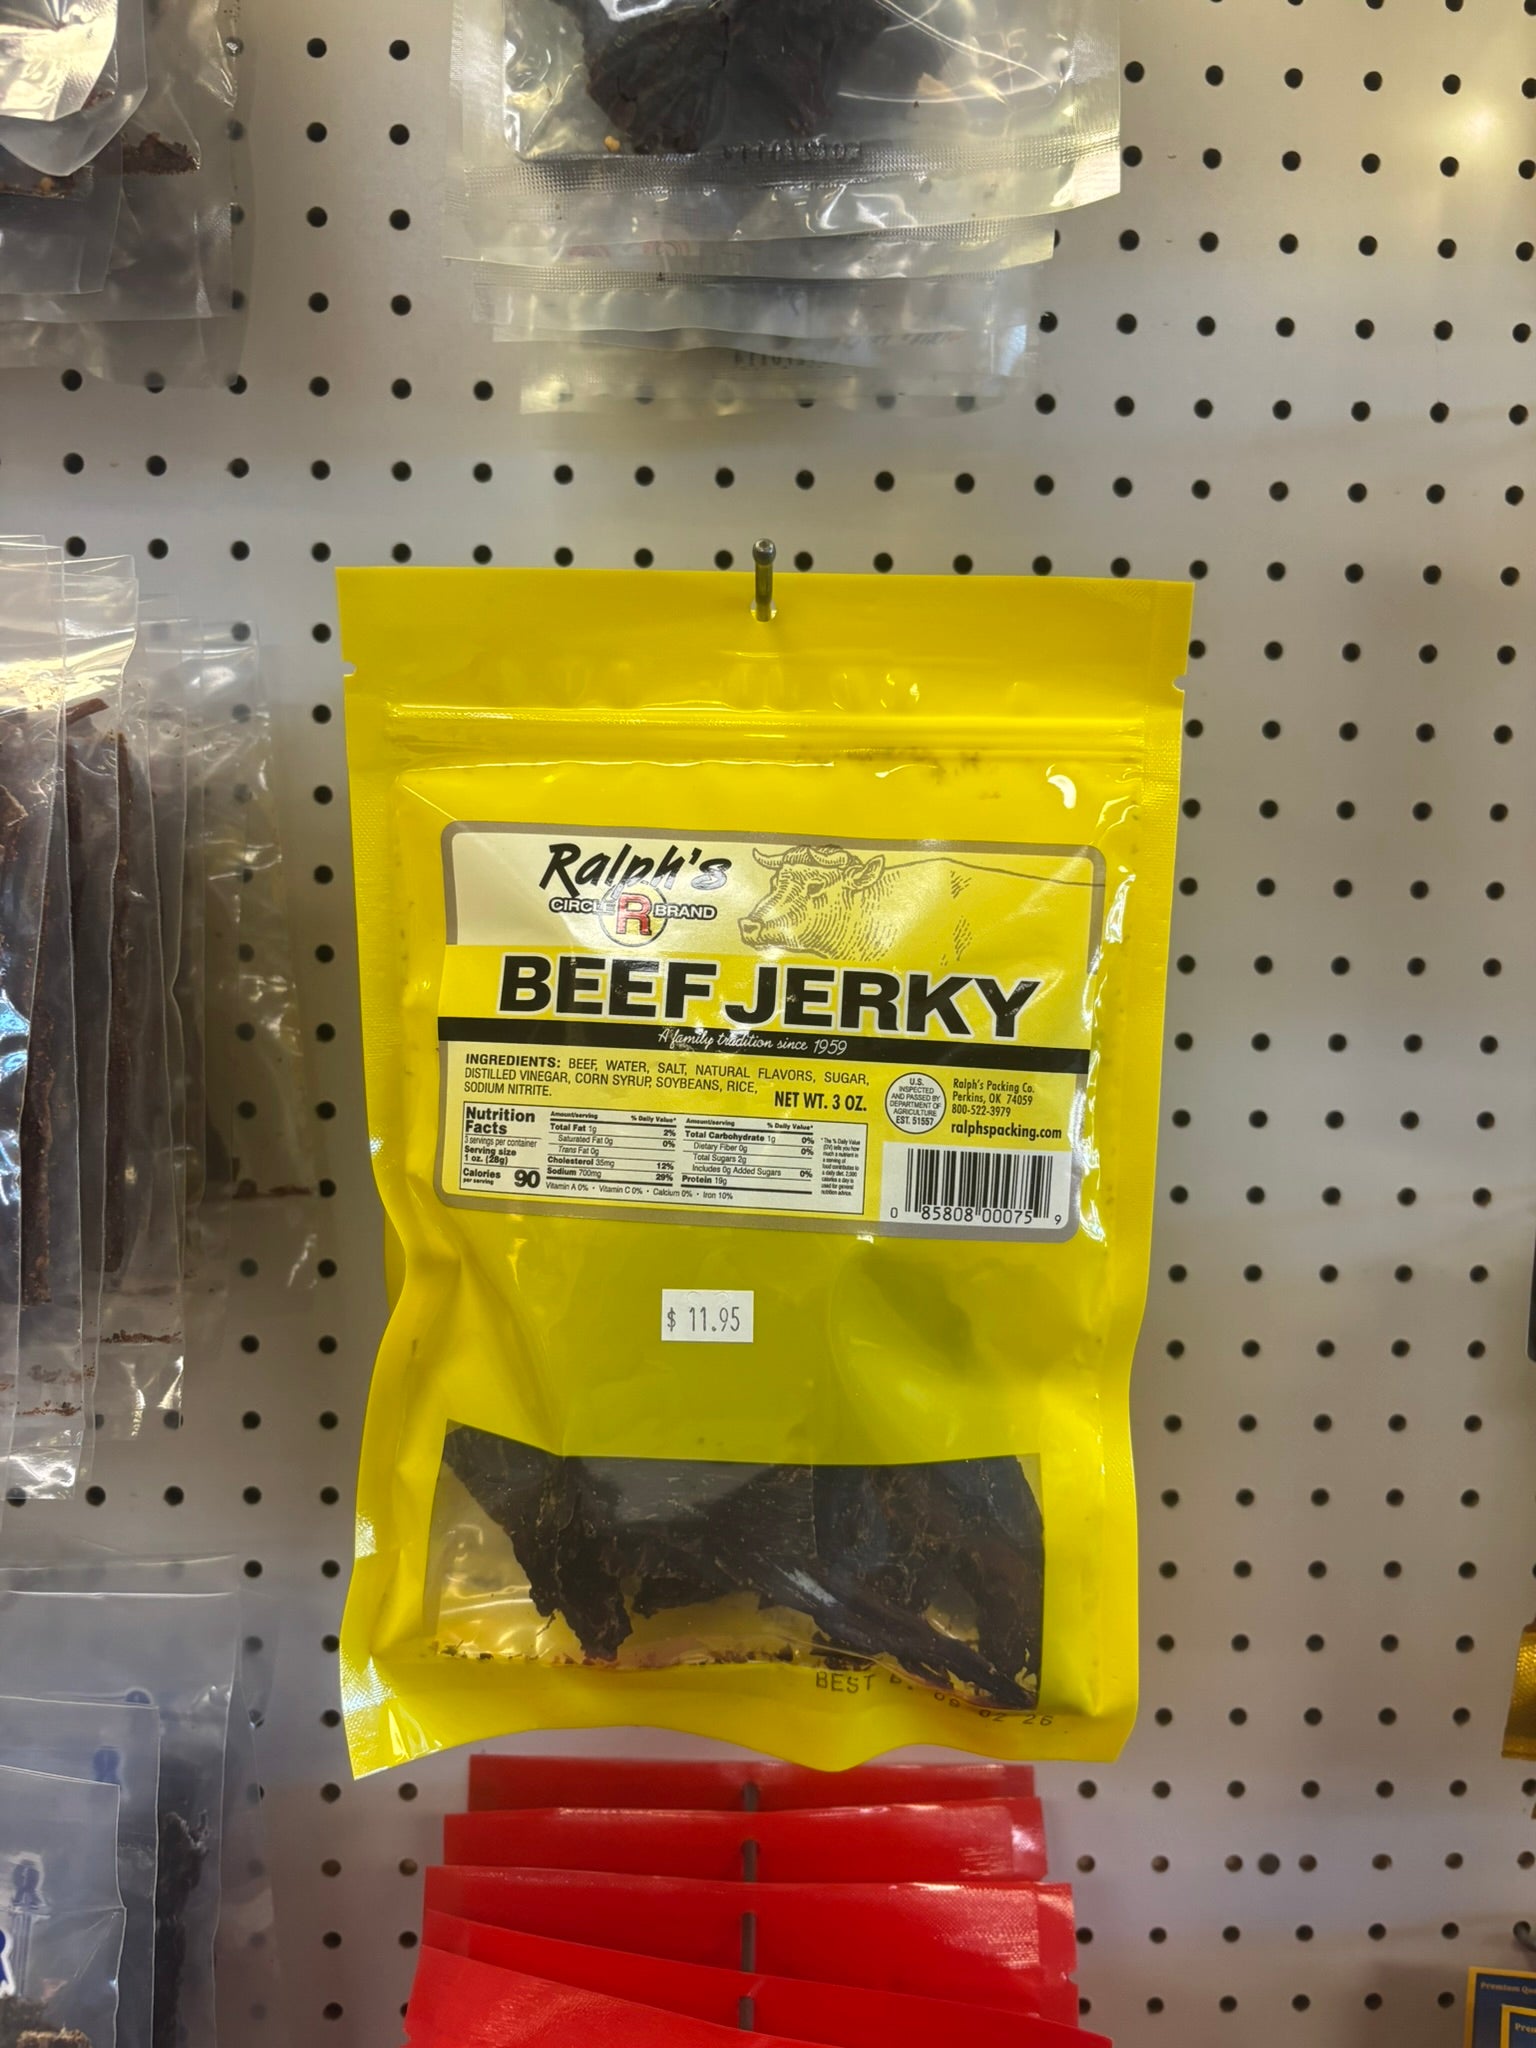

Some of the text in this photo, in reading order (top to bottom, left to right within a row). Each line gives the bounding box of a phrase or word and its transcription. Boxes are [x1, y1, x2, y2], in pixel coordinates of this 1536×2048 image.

[539, 842, 732, 898] Ralph's
[549, 892, 717, 936] CIRCLE R BRAND
[500, 956, 1041, 1038] BEEF JERKY
[658, 1030, 847, 1055] A family tradition since 1959
[466, 1053, 870, 1086] INGREDIENTS: BEEF, WATER, SALT, NATURAL FLAVORS, SUGAR,
[464, 1067, 758, 1094] DISTILLED VINEGAR, CORN SYRUP, SOYBEANS, RICE,
[909, 1078, 924, 1086] U.S.
[953, 1078, 1035, 1094] Ralph's Packing Co.
[464, 1082, 552, 1096] SODIUM NITRITE.
[899, 1086, 934, 1094] INSPECTED
[774, 1091, 867, 1111] NET WT. 3 OZ.
[889, 1100, 931, 1109] DEPARTMENT
[906, 1094, 931, 1102] PASSED
[952, 1091, 1033, 1106] Perkins, OK 74059
[466, 1106, 535, 1123] Nutrition
[893, 1108, 937, 1117] AGRICULTURE
[952, 1104, 1011, 1117] 800-522-3979
[465, 1120, 507, 1134] Facts
[895, 1116, 934, 1126] EST. 51557
[550, 1122, 676, 1137] Total Fat 1g 2%
[951, 1120, 1062, 1141] ralphspacking.com
[469, 1137, 494, 1147] servings
[495, 1138, 506, 1148] per
[507, 1139, 537, 1148] container
[558, 1134, 675, 1148] Saturated Fat 0g 0%
[685, 1130, 814, 1145] Total Carbohydrate 1g 0%
[464, 1145, 517, 1156] Serving size
[558, 1145, 576, 1154] Trans
[590, 1147, 599, 1157] 0g
[693, 1142, 814, 1156] Dietary Fiber 0g 0%
[486, 1155, 508, 1165] (28g)
[547, 1156, 594, 1166] Cholesterol
[595, 1159, 615, 1169] 35mg
[693, 1153, 747, 1164] Total Sugars 2g
[463, 1168, 540, 1188] Calories 90
[547, 1167, 673, 1181] Sodium 700mg 29%
[692, 1164, 813, 1178] Includes 0g Added Sugars 0%
[682, 1175, 727, 1186] Protein 19g
[545, 1182, 570, 1190] Vitamin
[599, 1185, 623, 1193] Vitamin
[632, 1187, 643, 1195] 0%
[653, 1188, 680, 1197] Calcium
[681, 1190, 692, 1198] 0%
[703, 1191, 716, 1199] Iron
[718, 1192, 733, 1200] 10%
[890, 1206, 1062, 1225] 0 85808 00075 9
[667, 1306, 740, 1332] $ 11.95
[816, 1671, 876, 1693] BEST
[1022, 1714, 1054, 1726] 26
[1480, 1982, 1520, 1992] Premium
